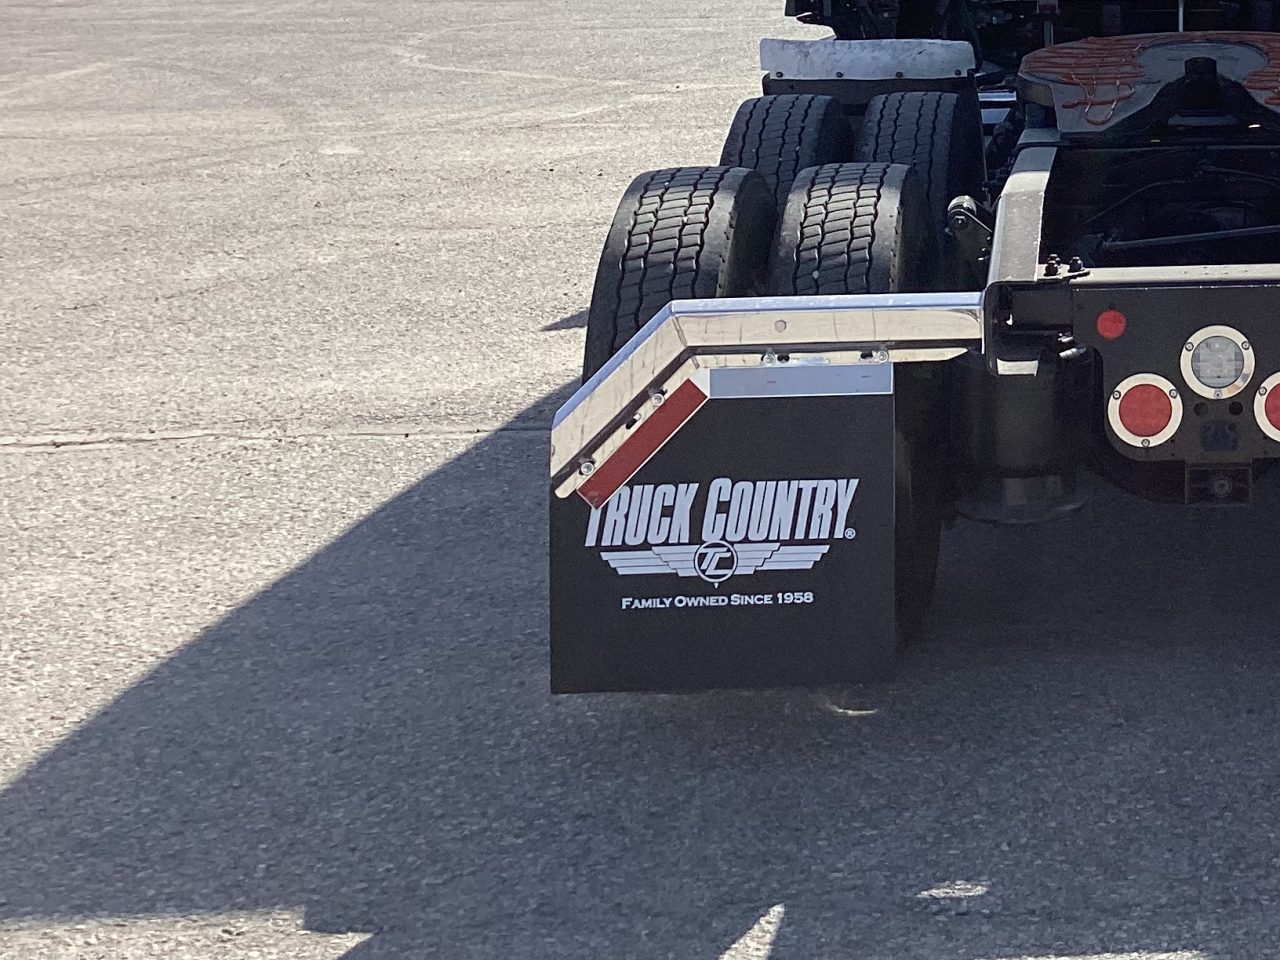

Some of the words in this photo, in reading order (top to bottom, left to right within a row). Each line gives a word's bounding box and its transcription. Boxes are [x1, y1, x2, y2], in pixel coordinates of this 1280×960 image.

[701, 477, 860, 542] COUNTRY
[621, 597, 672, 610] FAMILY
[674, 595, 728, 608] OWNED
[730, 593, 773, 606] SINCE
[776, 591, 814, 605] 1958
